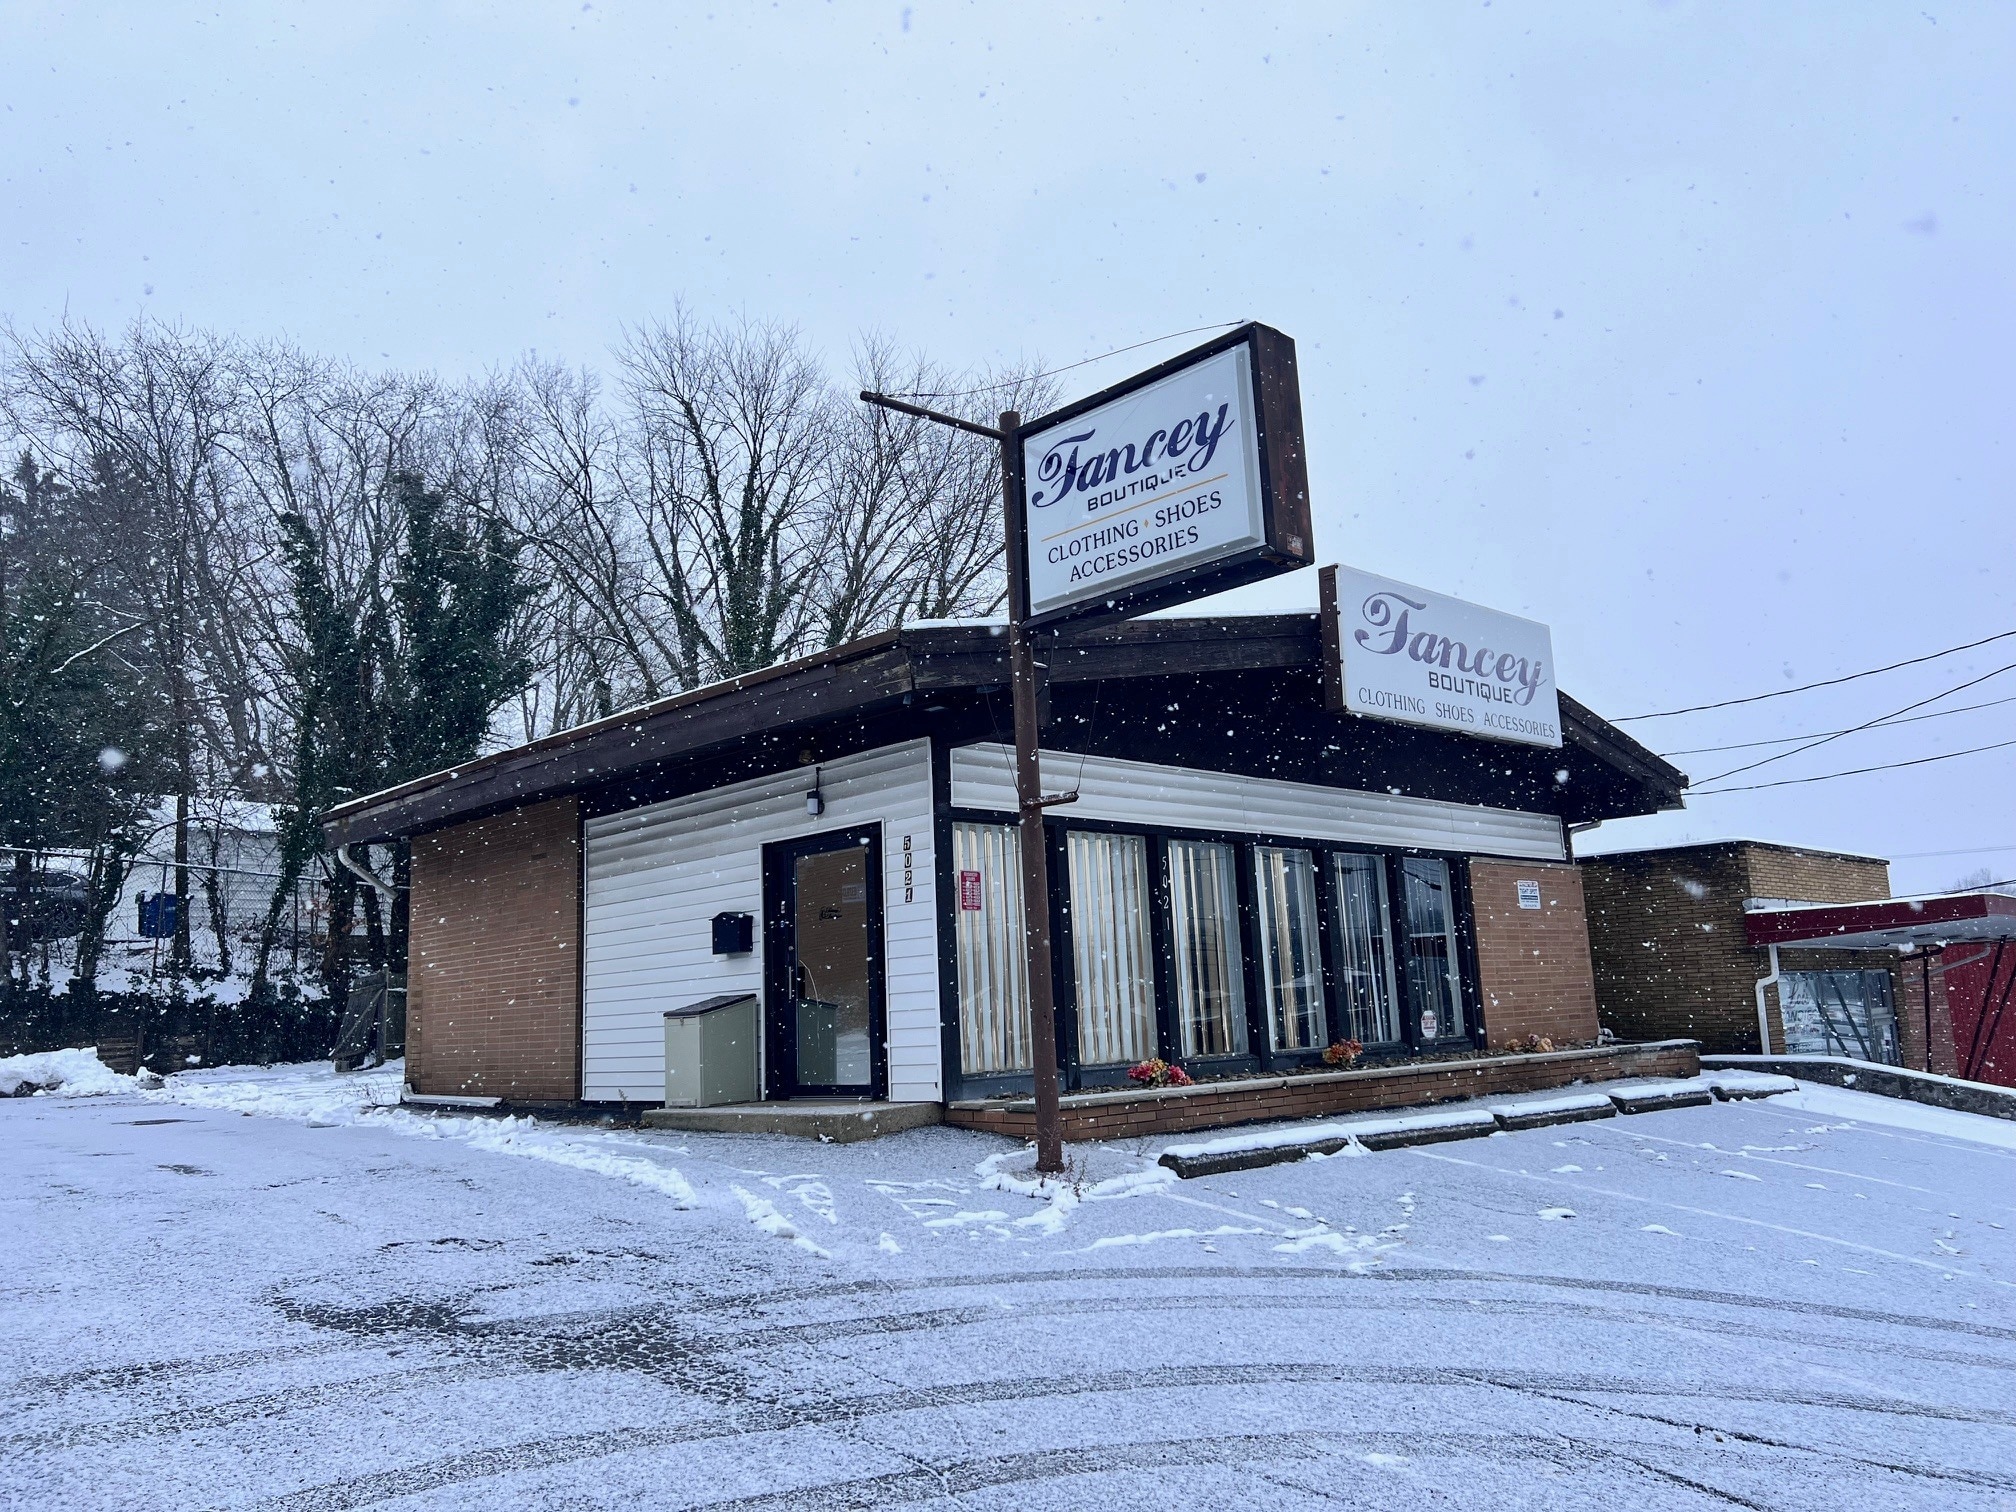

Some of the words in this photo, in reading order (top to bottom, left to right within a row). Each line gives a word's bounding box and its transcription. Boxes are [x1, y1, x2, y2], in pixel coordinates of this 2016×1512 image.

[1031, 403, 1235, 508] Fancey
[1087, 463, 1187, 512] BOUTIQUE
[1047, 519, 1139, 564] CLOTHING
[1154, 490, 1222, 528] SHOES
[1069, 525, 1199, 582] ACCESSORIES
[1354, 591, 1547, 706] Fancey
[1358, 687, 1426, 714] CLOTHING
[1435, 702, 1475, 723] SHOES
[1483, 712, 1556, 738] ACCESSORIES
[1428, 670, 1513, 704] BOUTIQUE
